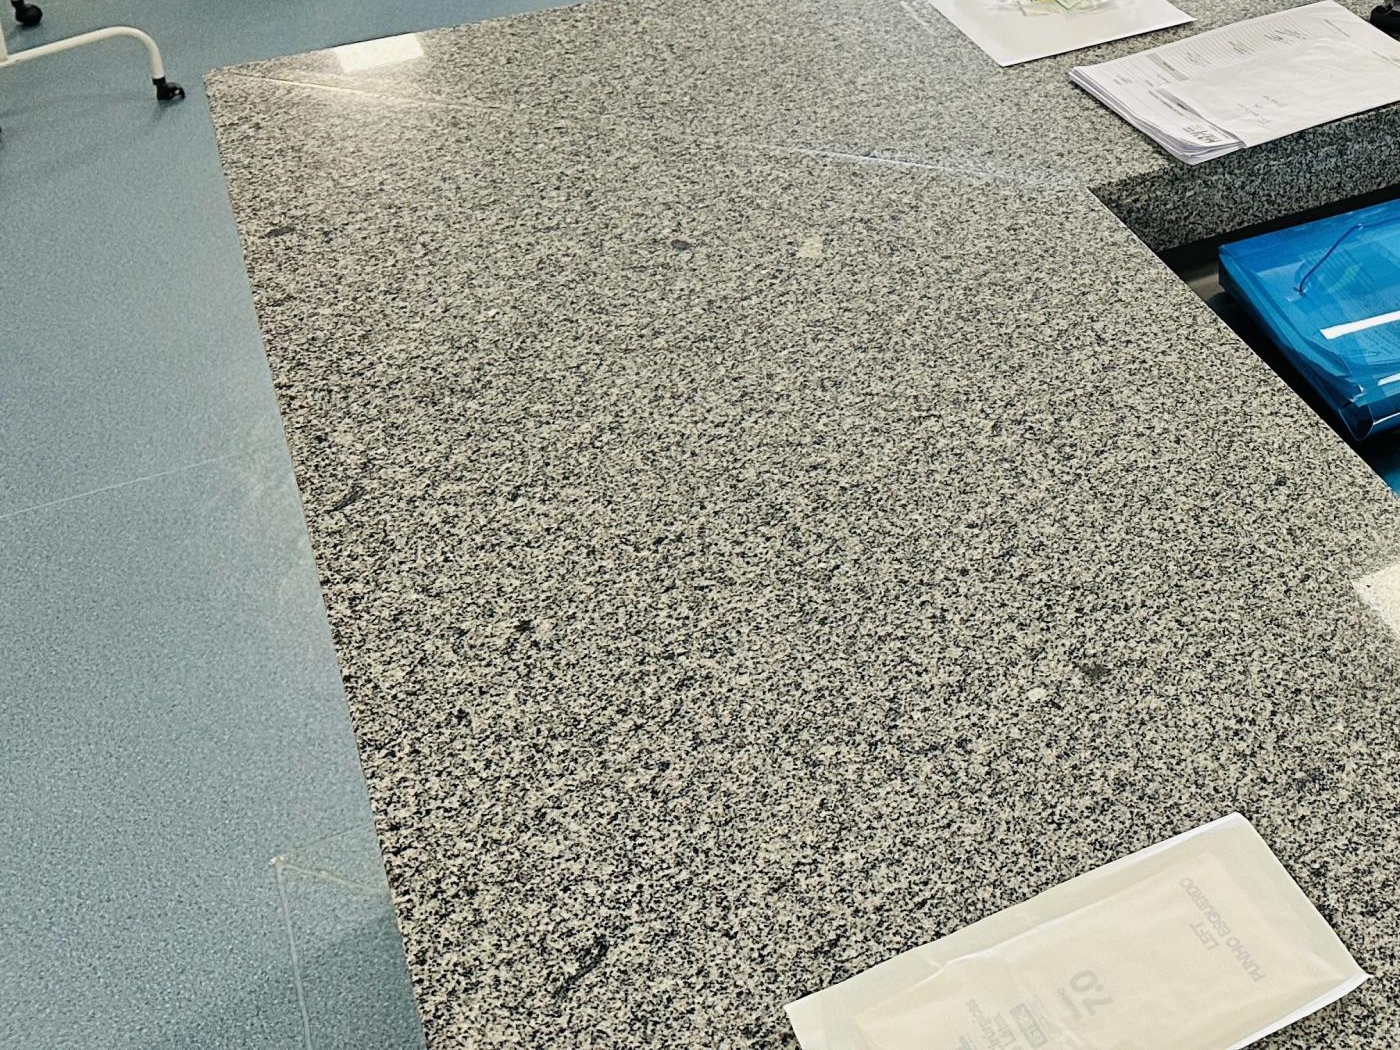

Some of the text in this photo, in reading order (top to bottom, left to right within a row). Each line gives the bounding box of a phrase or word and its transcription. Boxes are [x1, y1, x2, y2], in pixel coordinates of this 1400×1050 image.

[1179, 877, 1267, 983] PUNHO ESQUERDO
[1190, 921, 1220, 951] LEFT
[1069, 970, 1113, 1016] 7.0
